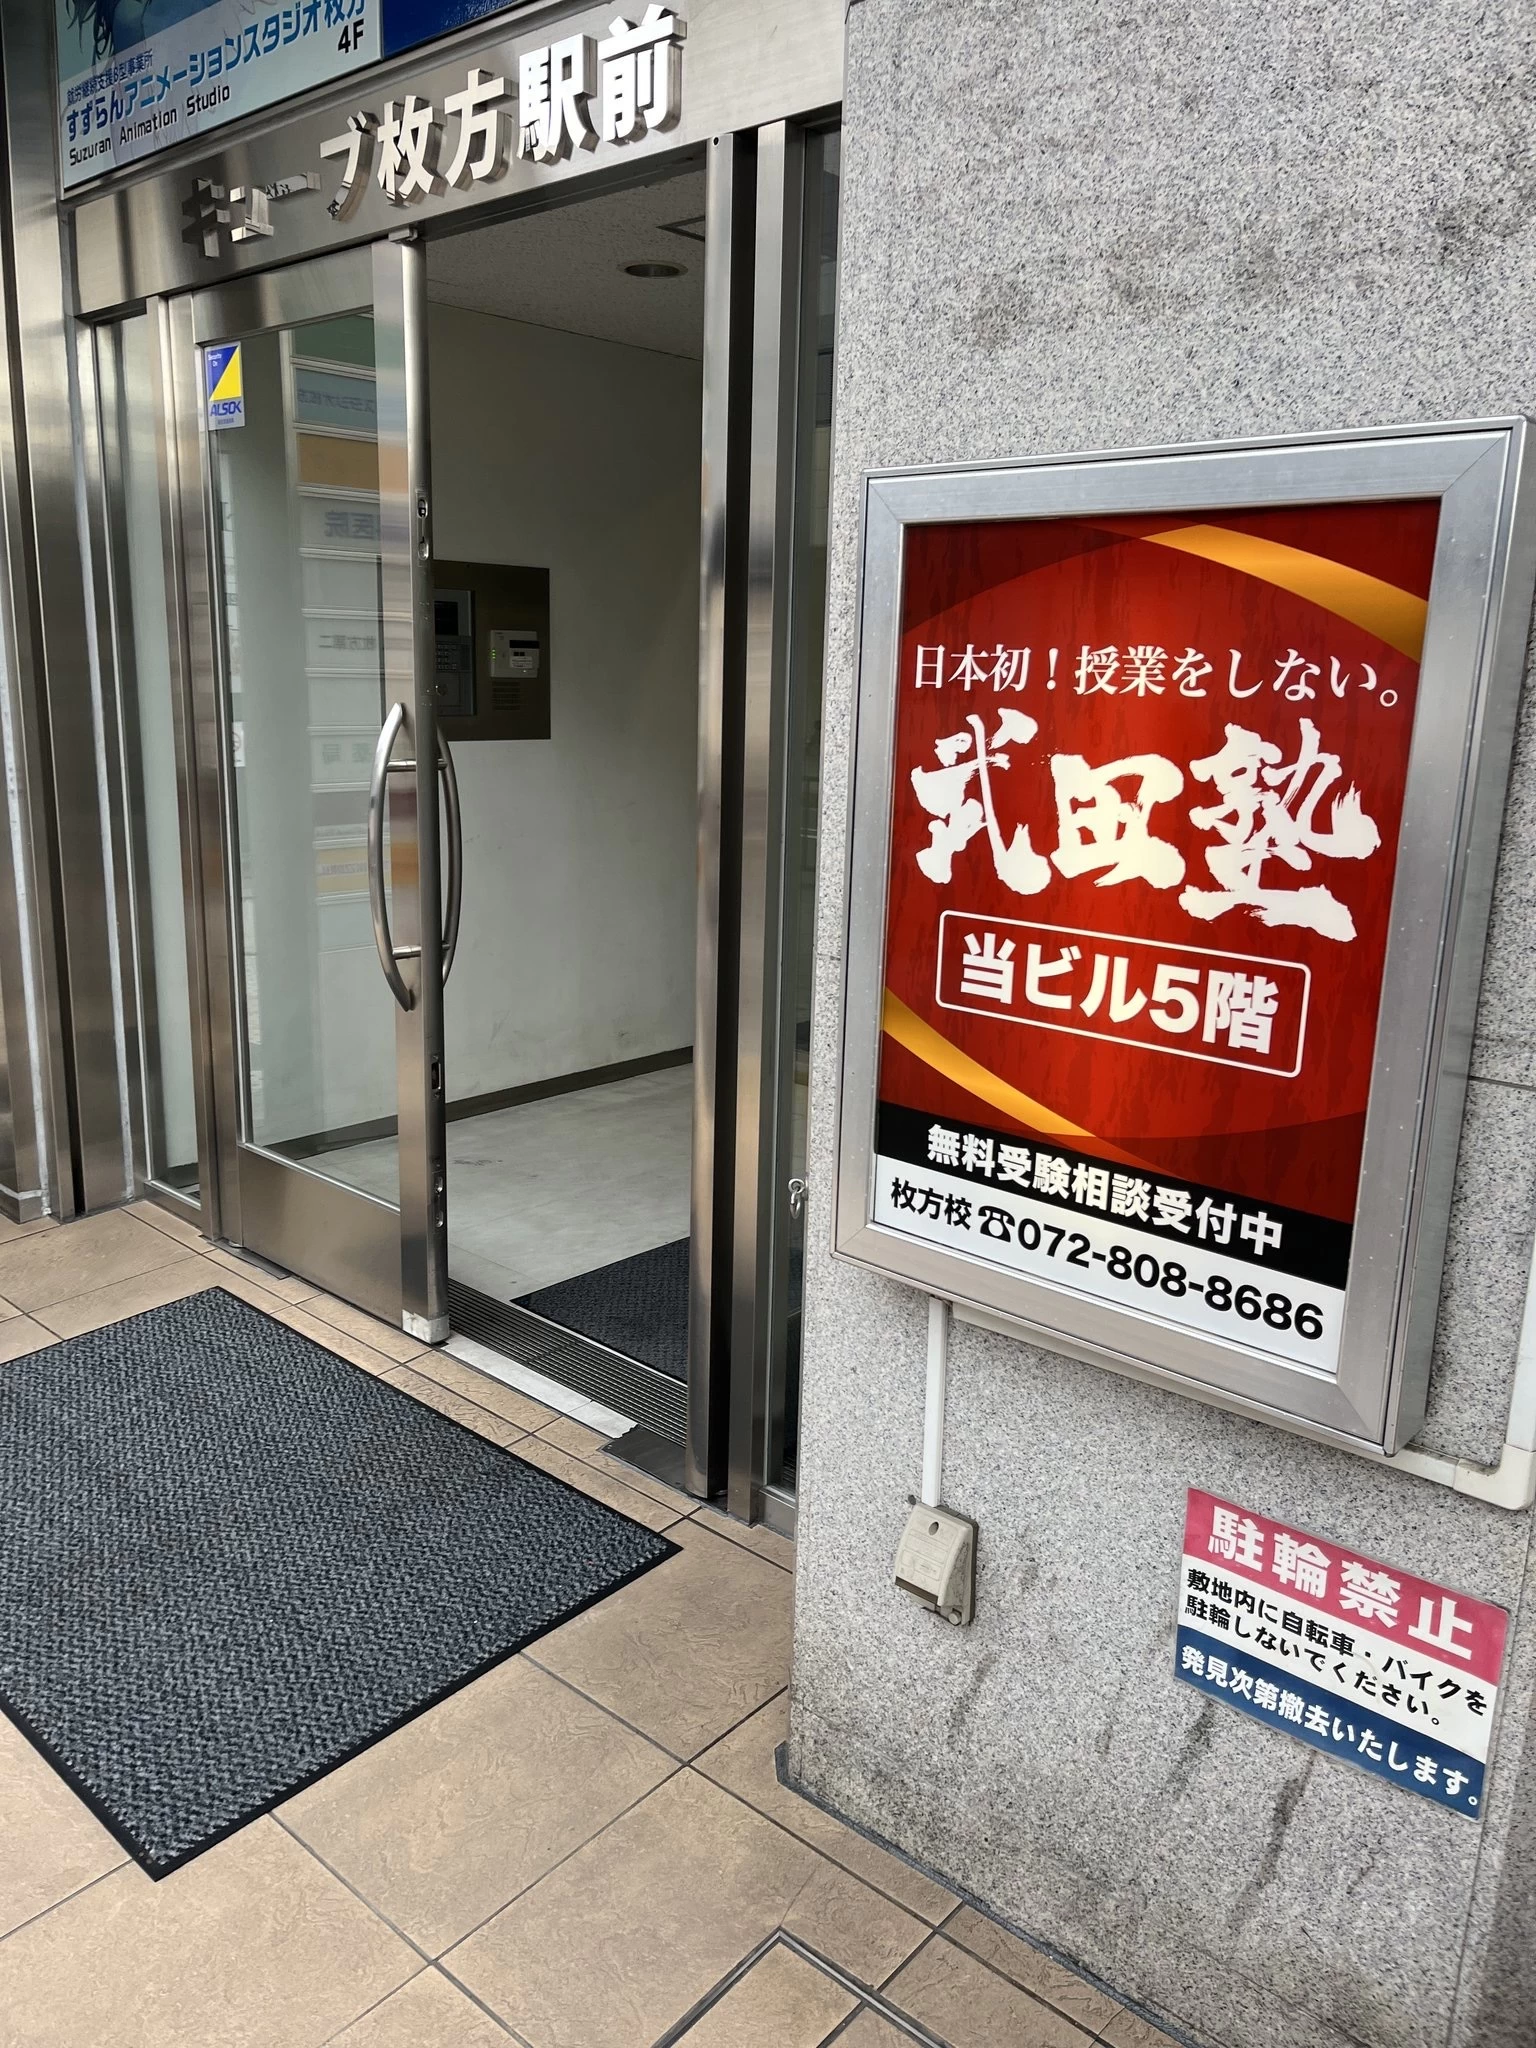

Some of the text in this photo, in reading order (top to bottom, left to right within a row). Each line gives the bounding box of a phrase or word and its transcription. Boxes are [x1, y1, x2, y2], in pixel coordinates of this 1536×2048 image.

[337, 18, 365, 54] 4F
[69, 84, 231, 167] Suzuran Animation Studio
[210, 400, 242, 417] ALSOK
[913, 643, 1399, 708] 日本初！授業をしない。
[910, 707, 1382, 943] 武田塾
[960, 932, 1280, 1055] 当ビル5階
[926, 1123, 1285, 1257] 無料受験相談受付中
[889, 1176, 1326, 1341] 枚方校 072-808-8686
[1186, 1567, 1488, 1717] 敷地内に自転車・バイクを
[1207, 1504, 1474, 1661] 駐輪禁止
[1180, 1644, 1479, 1807] 発見次第撤去いたします。
[1183, 1593, 1441, 1727] 駐輪しないでください。
